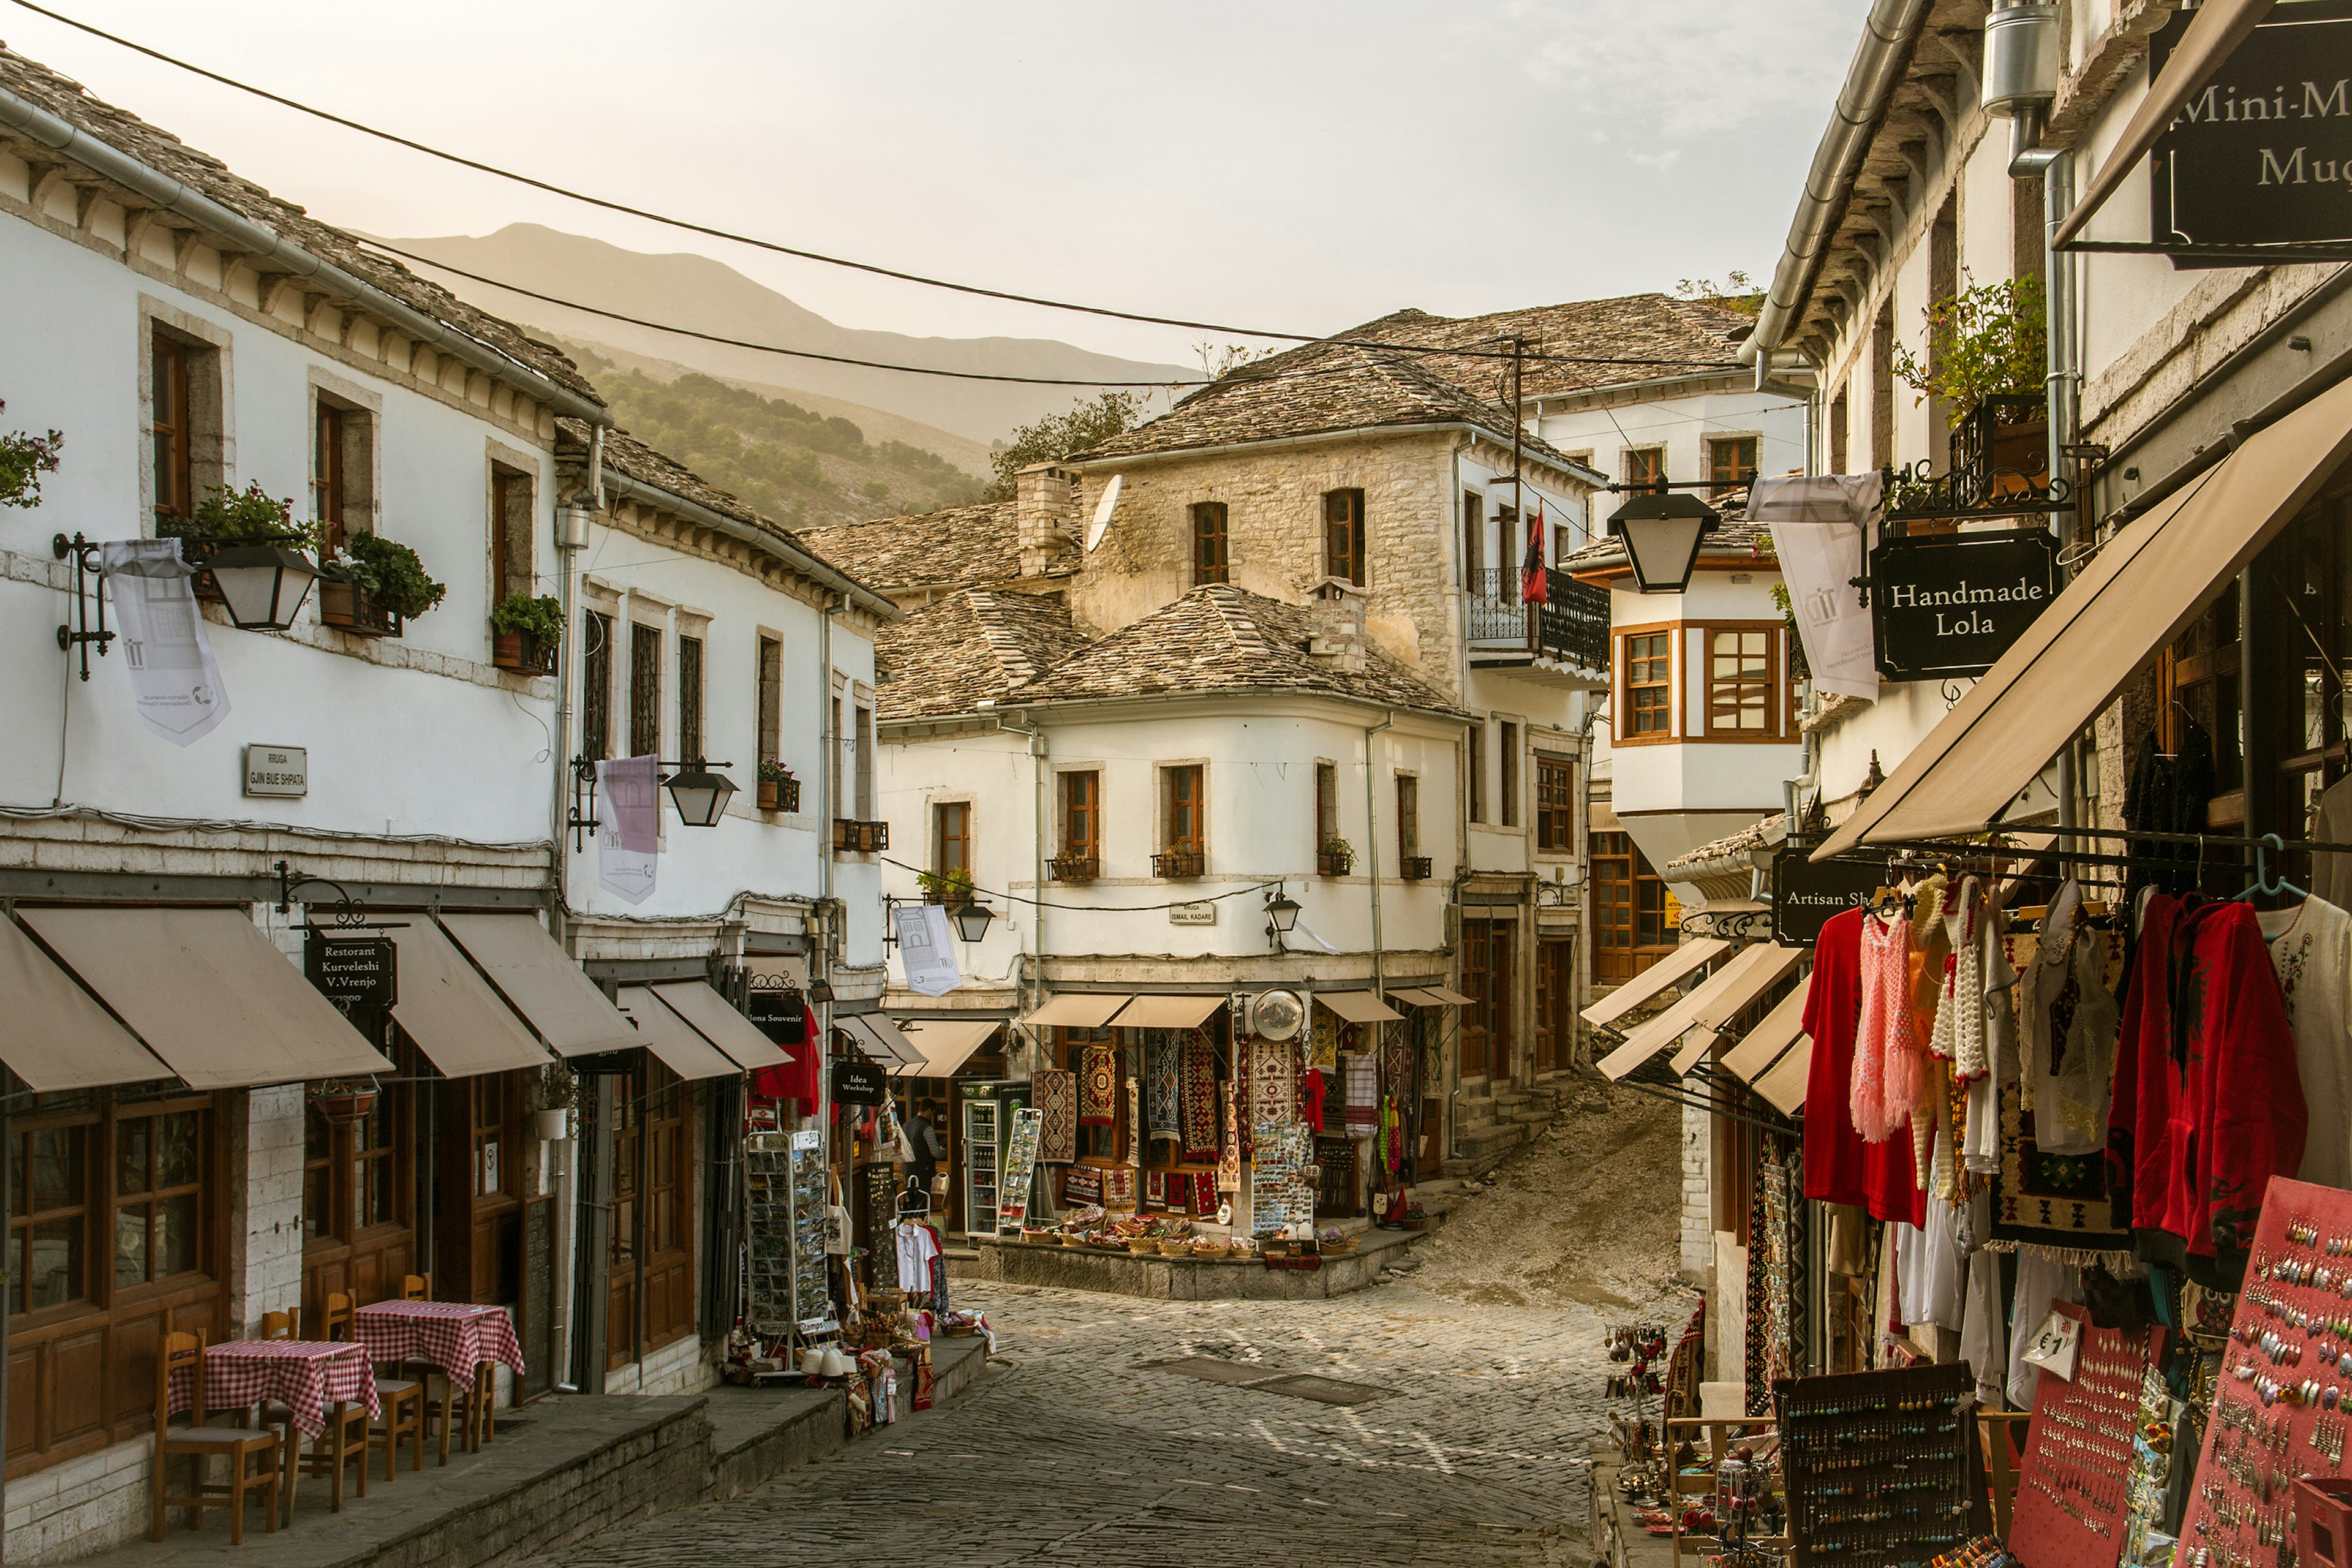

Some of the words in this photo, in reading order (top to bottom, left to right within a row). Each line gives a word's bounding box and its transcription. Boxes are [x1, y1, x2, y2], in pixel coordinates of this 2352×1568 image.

[1891, 576, 2043, 608] Handmade
[1936, 609, 1996, 636] Lola
[268, 753, 287, 764] RRUGA
[251, 772, 265, 784] GJIN
[266, 772, 279, 785] BUE
[281, 774, 304, 786] SHPATA
[1787, 891, 1845, 905] Artisan
[325, 947, 375, 957] Restorant
[322, 961, 379, 972] Kurveleshi
[326, 976, 377, 989] V.Vrenjo
[767, 1014, 802, 1022] Souvenir
[850, 1075, 867, 1084] Idea
[842, 1084, 874, 1093] Workshop
[760, 1324, 787, 1333] Stamps
[801, 1321, 824, 1333] Stamps
[2061, 1321, 2071, 1335] all
